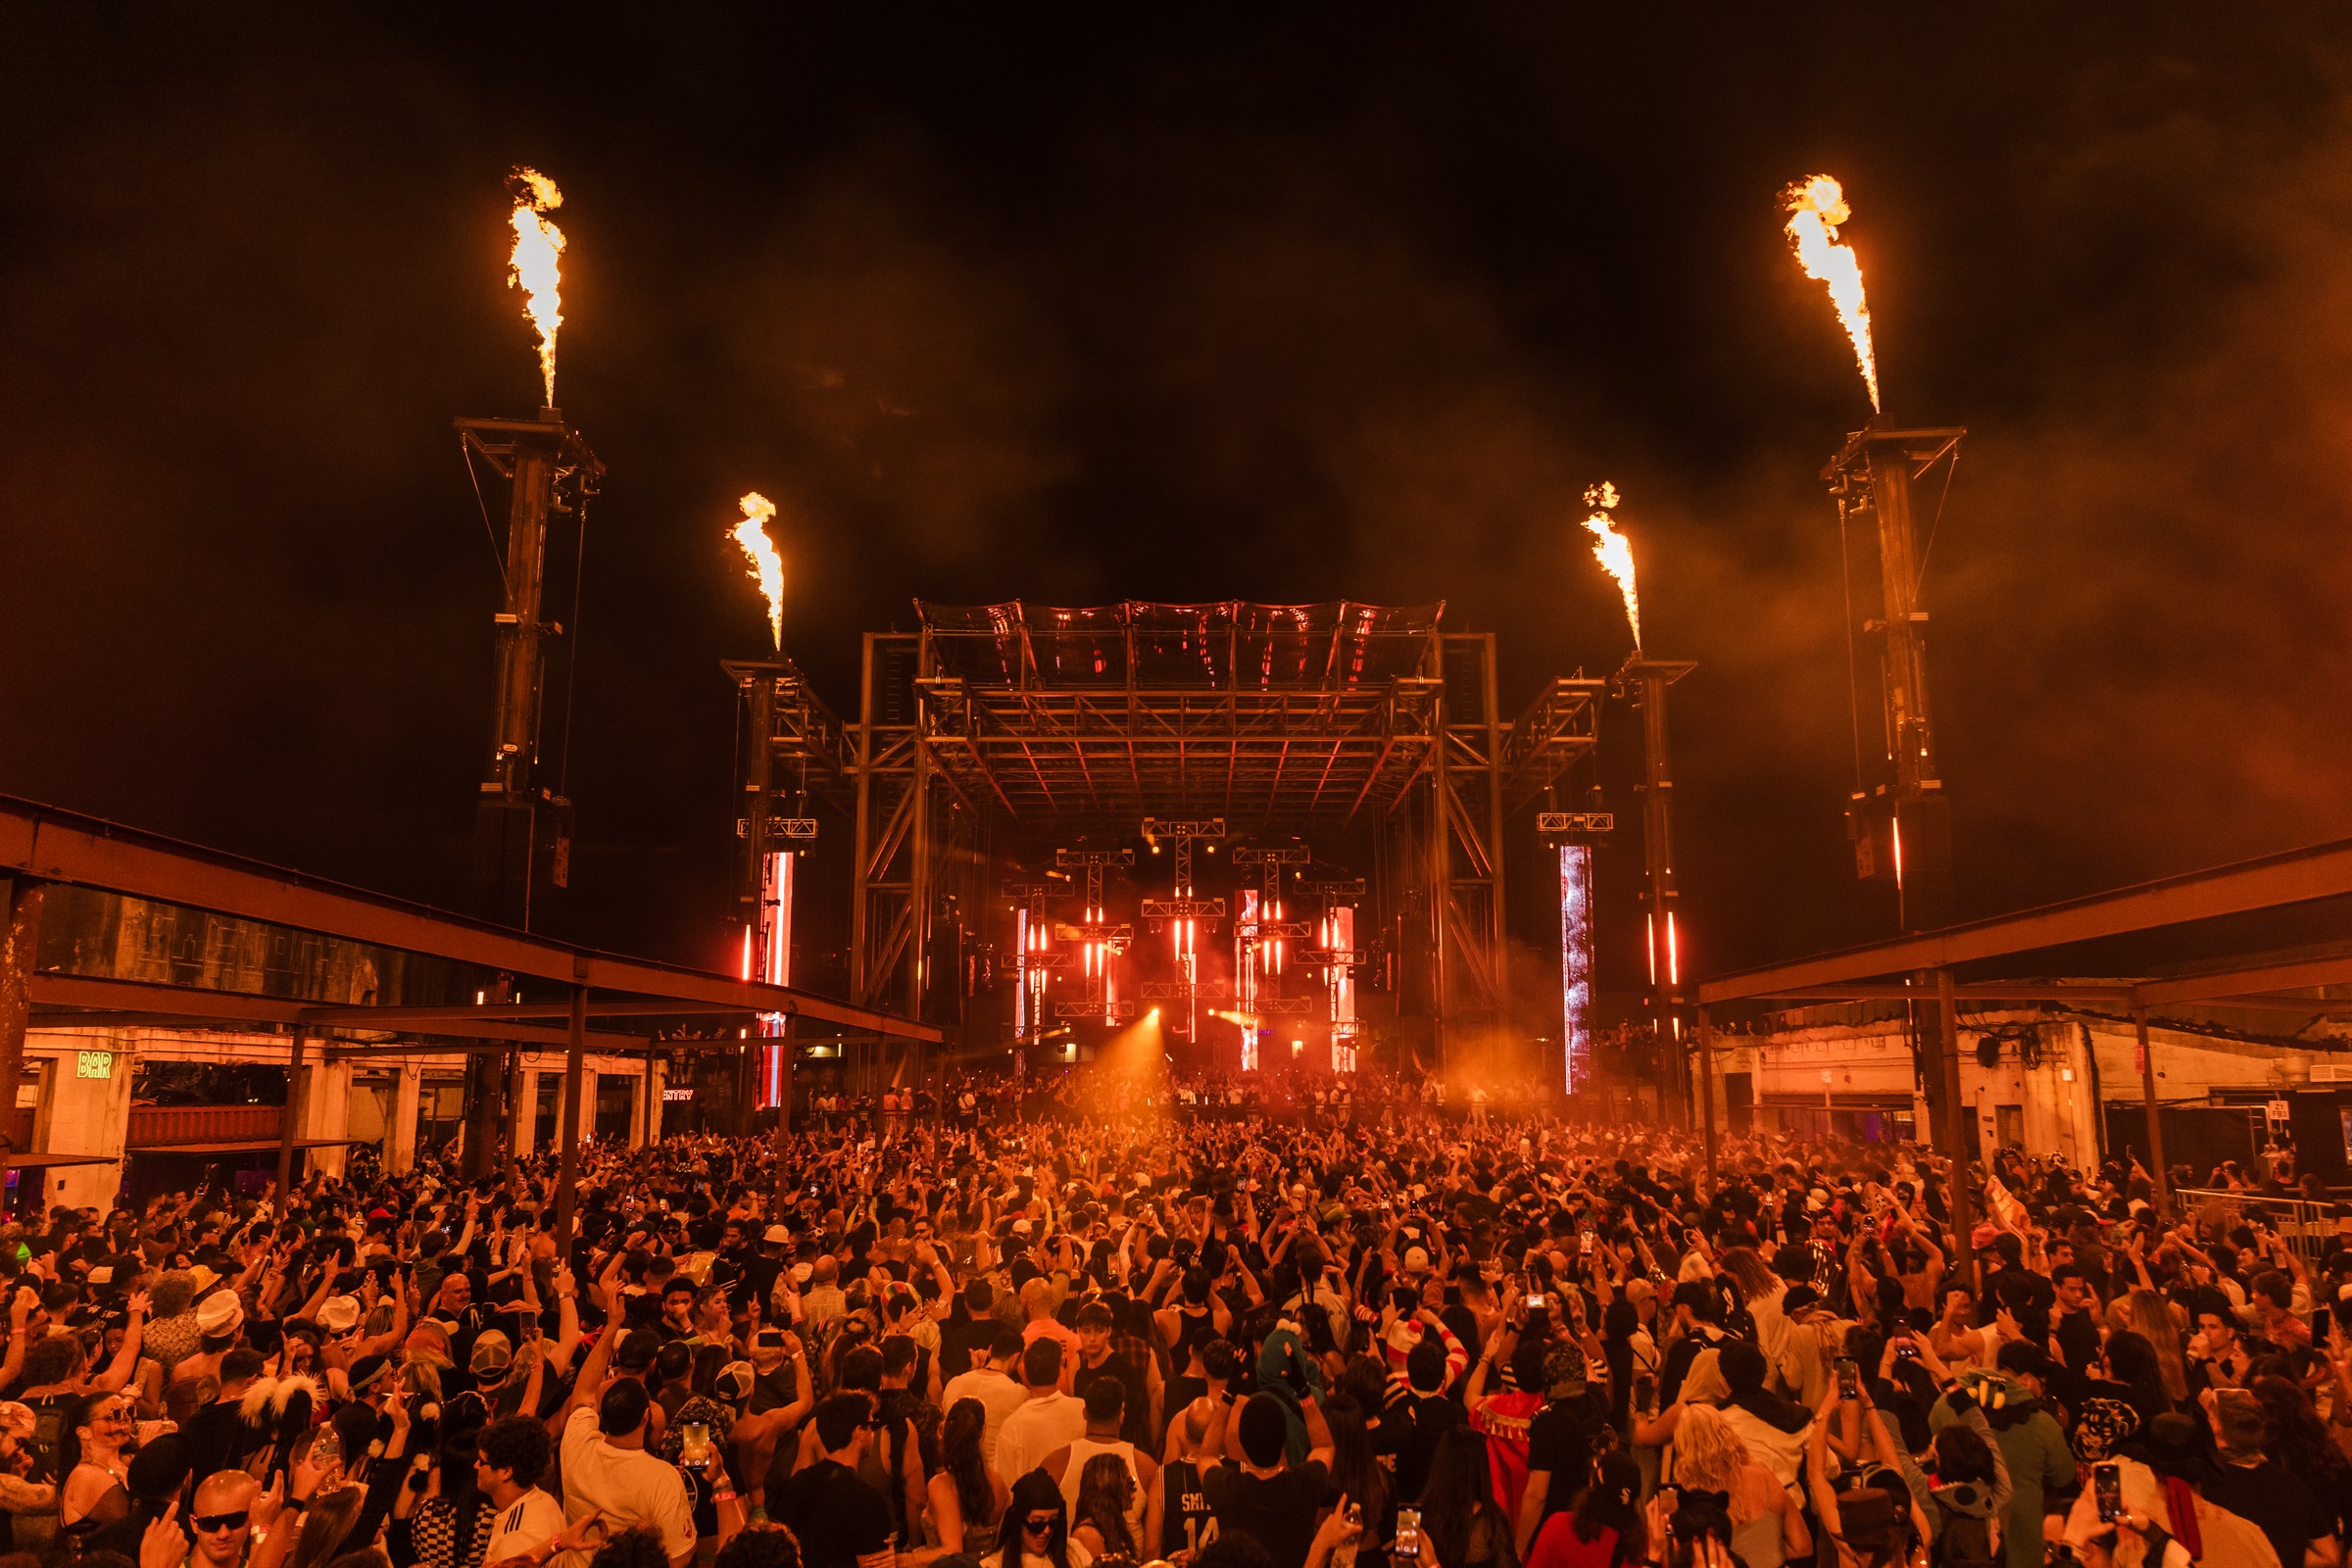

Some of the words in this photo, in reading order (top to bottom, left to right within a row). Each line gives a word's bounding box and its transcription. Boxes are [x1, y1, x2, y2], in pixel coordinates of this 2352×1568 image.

[76, 1051, 112, 1078] BAR
[1181, 1492, 1212, 1512] SMI
[1183, 1516, 1220, 1552] 14
